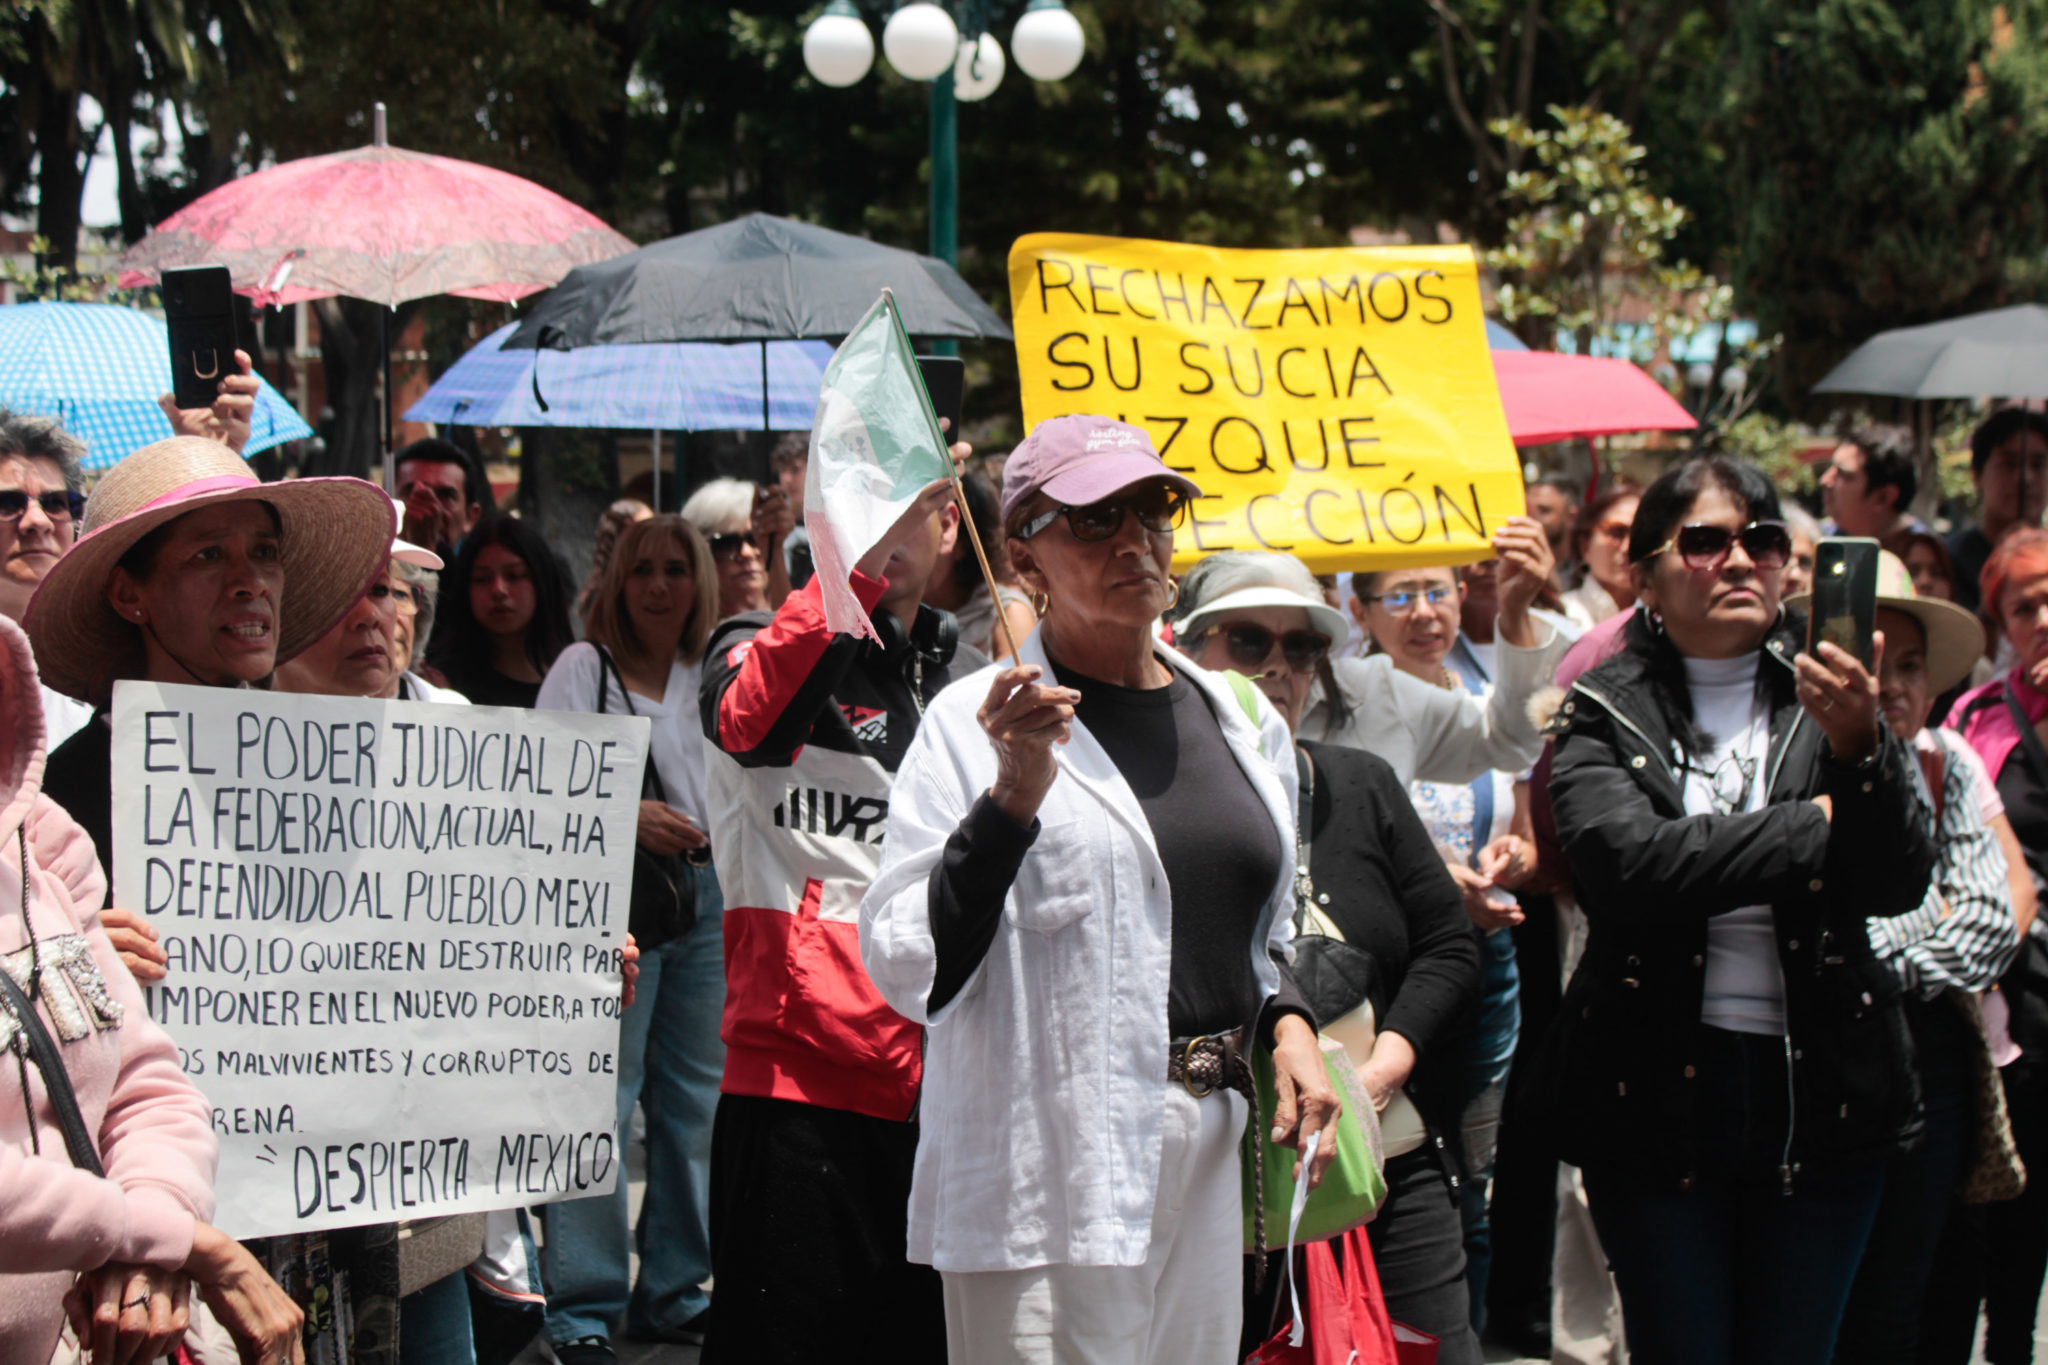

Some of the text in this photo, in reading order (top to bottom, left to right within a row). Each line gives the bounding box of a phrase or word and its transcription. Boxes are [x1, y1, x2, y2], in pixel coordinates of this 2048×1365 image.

[1037, 258, 1453, 329] RECHAZAMOS
[1047, 332, 1393, 398] SU SUCIA
[1053, 413, 1387, 474] ZQUE
[1173, 472, 1487, 552] ECCIÓN
[144, 711, 617, 798] EL PODER JUDICIAL DE
[144, 784, 196, 847] LA
[562, 813, 606, 856] HA
[144, 857, 346, 923] DEFENDIDO
[348, 872, 393, 919] AL
[404, 870, 526, 927] PUEBLO
[164, 933, 250, 981] ANO,
[300, 941, 425, 974] QUIEREN
[440, 939, 572, 973] DESTRUIR
[145, 985, 299, 1026] IMPONER
[309, 991, 347, 1025] EN
[355, 991, 386, 1024] EL
[393, 990, 478, 1022] NUEVO
[571, 998, 584, 1020] A
[217, 1048, 394, 1076] MALVIVIENTES
[401, 1049, 414, 1077] Y
[422, 1048, 572, 1076] CORRUPTOS
[588, 1051, 614, 1074] DE
[211, 1104, 304, 1135] RENA.
